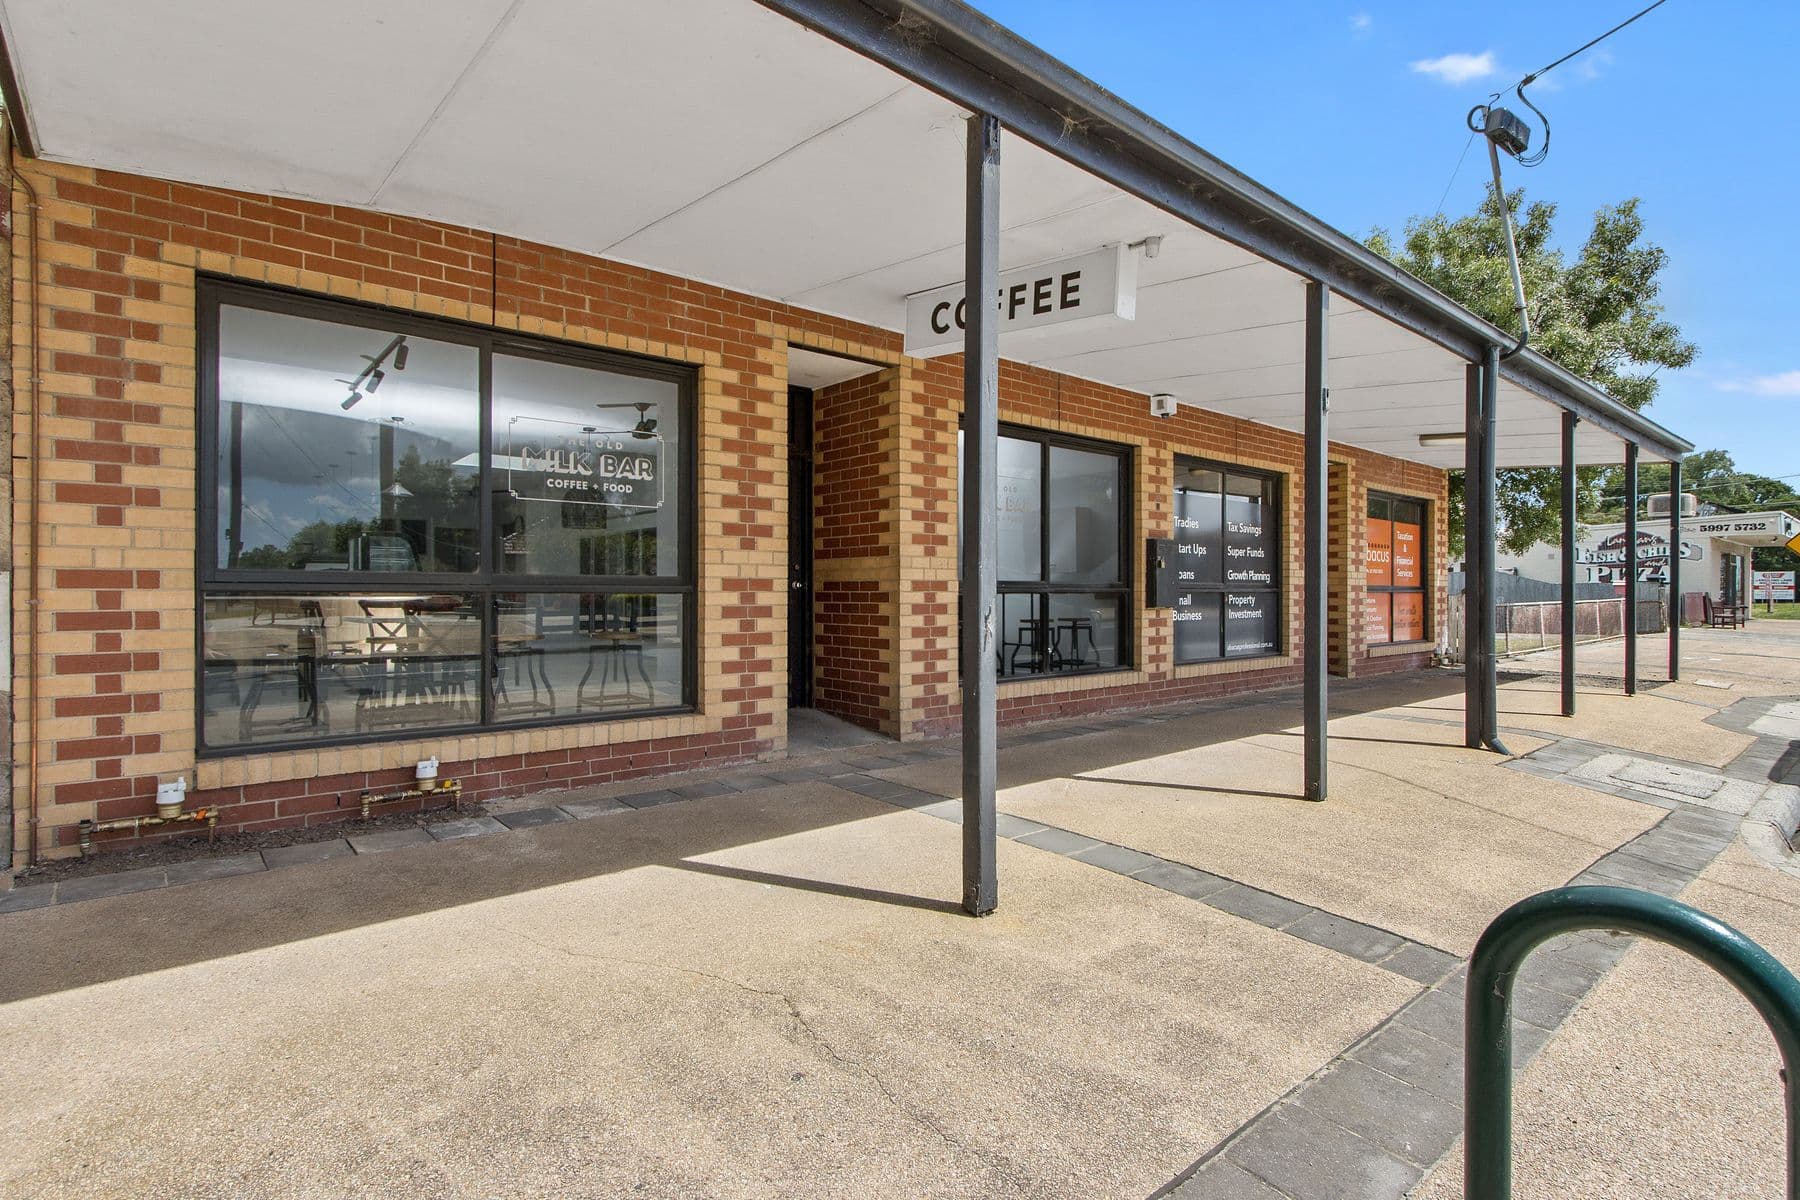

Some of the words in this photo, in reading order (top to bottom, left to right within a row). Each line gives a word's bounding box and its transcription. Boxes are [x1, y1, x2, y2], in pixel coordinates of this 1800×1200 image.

[931, 270, 1081, 334] CFEE
[595, 440, 624, 450] OLD
[522, 446, 592, 476] MILK
[600, 454, 654, 481] BAR
[546, 478, 589, 490] COFFEE
[603, 482, 633, 494] FOOD
[1174, 516, 1200, 529] Tradies
[1227, 521, 1239, 533] Tax
[1239, 523, 1262, 537] Savings
[1699, 524, 1731, 533] 5997
[1734, 522, 1767, 532] 5732
[1178, 543, 1192, 554] tart
[1193, 544, 1207, 557] Ups
[1227, 545, 1246, 559] Super
[1246, 547, 1265, 558] Funds
[1576, 547, 1615, 564] FISH
[1227, 569, 1249, 581] Growth
[1248, 570, 1271, 584] Planning
[1588, 565, 1671, 583] PIZA
[1228, 594, 1256, 607] Property
[1172, 611, 1202, 621] Business
[1228, 609, 1262, 619] Investment
